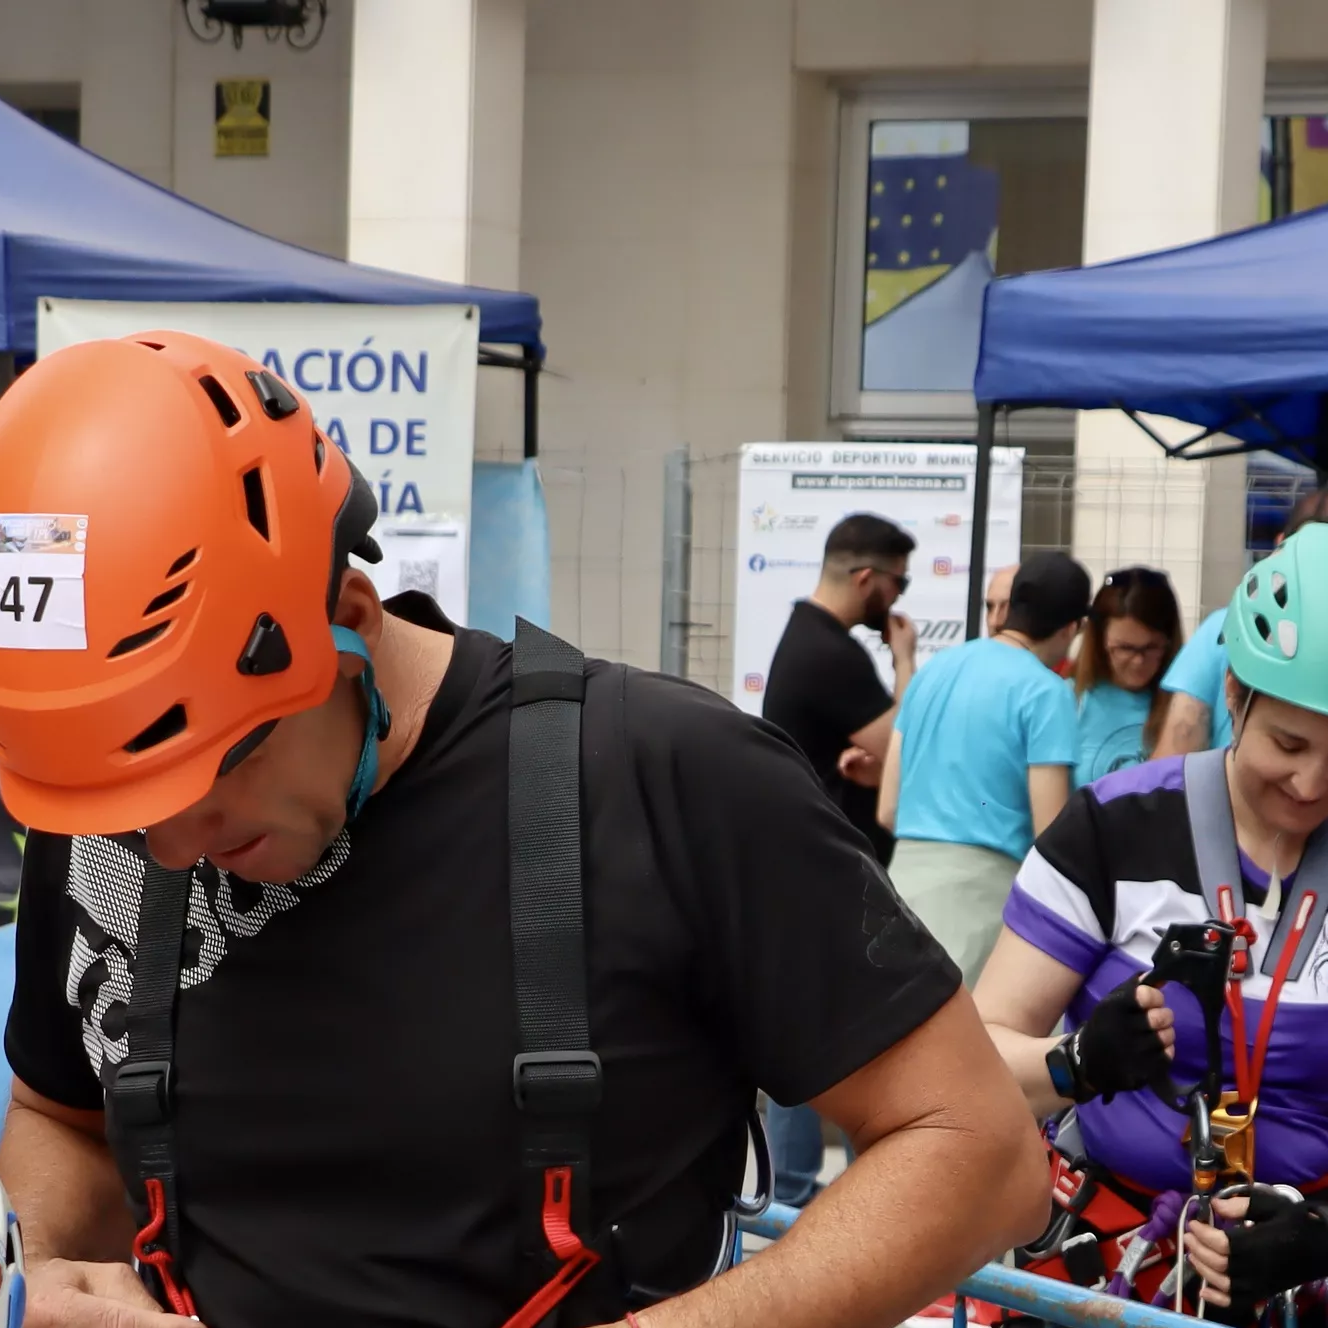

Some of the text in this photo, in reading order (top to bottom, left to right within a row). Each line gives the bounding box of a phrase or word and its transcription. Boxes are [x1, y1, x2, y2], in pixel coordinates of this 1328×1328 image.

[237, 336, 428, 393] ACIÓN
[369, 417, 428, 457] DE
[832, 451, 918, 466] DEPORTIVO
[0, 576, 54, 622] 47
